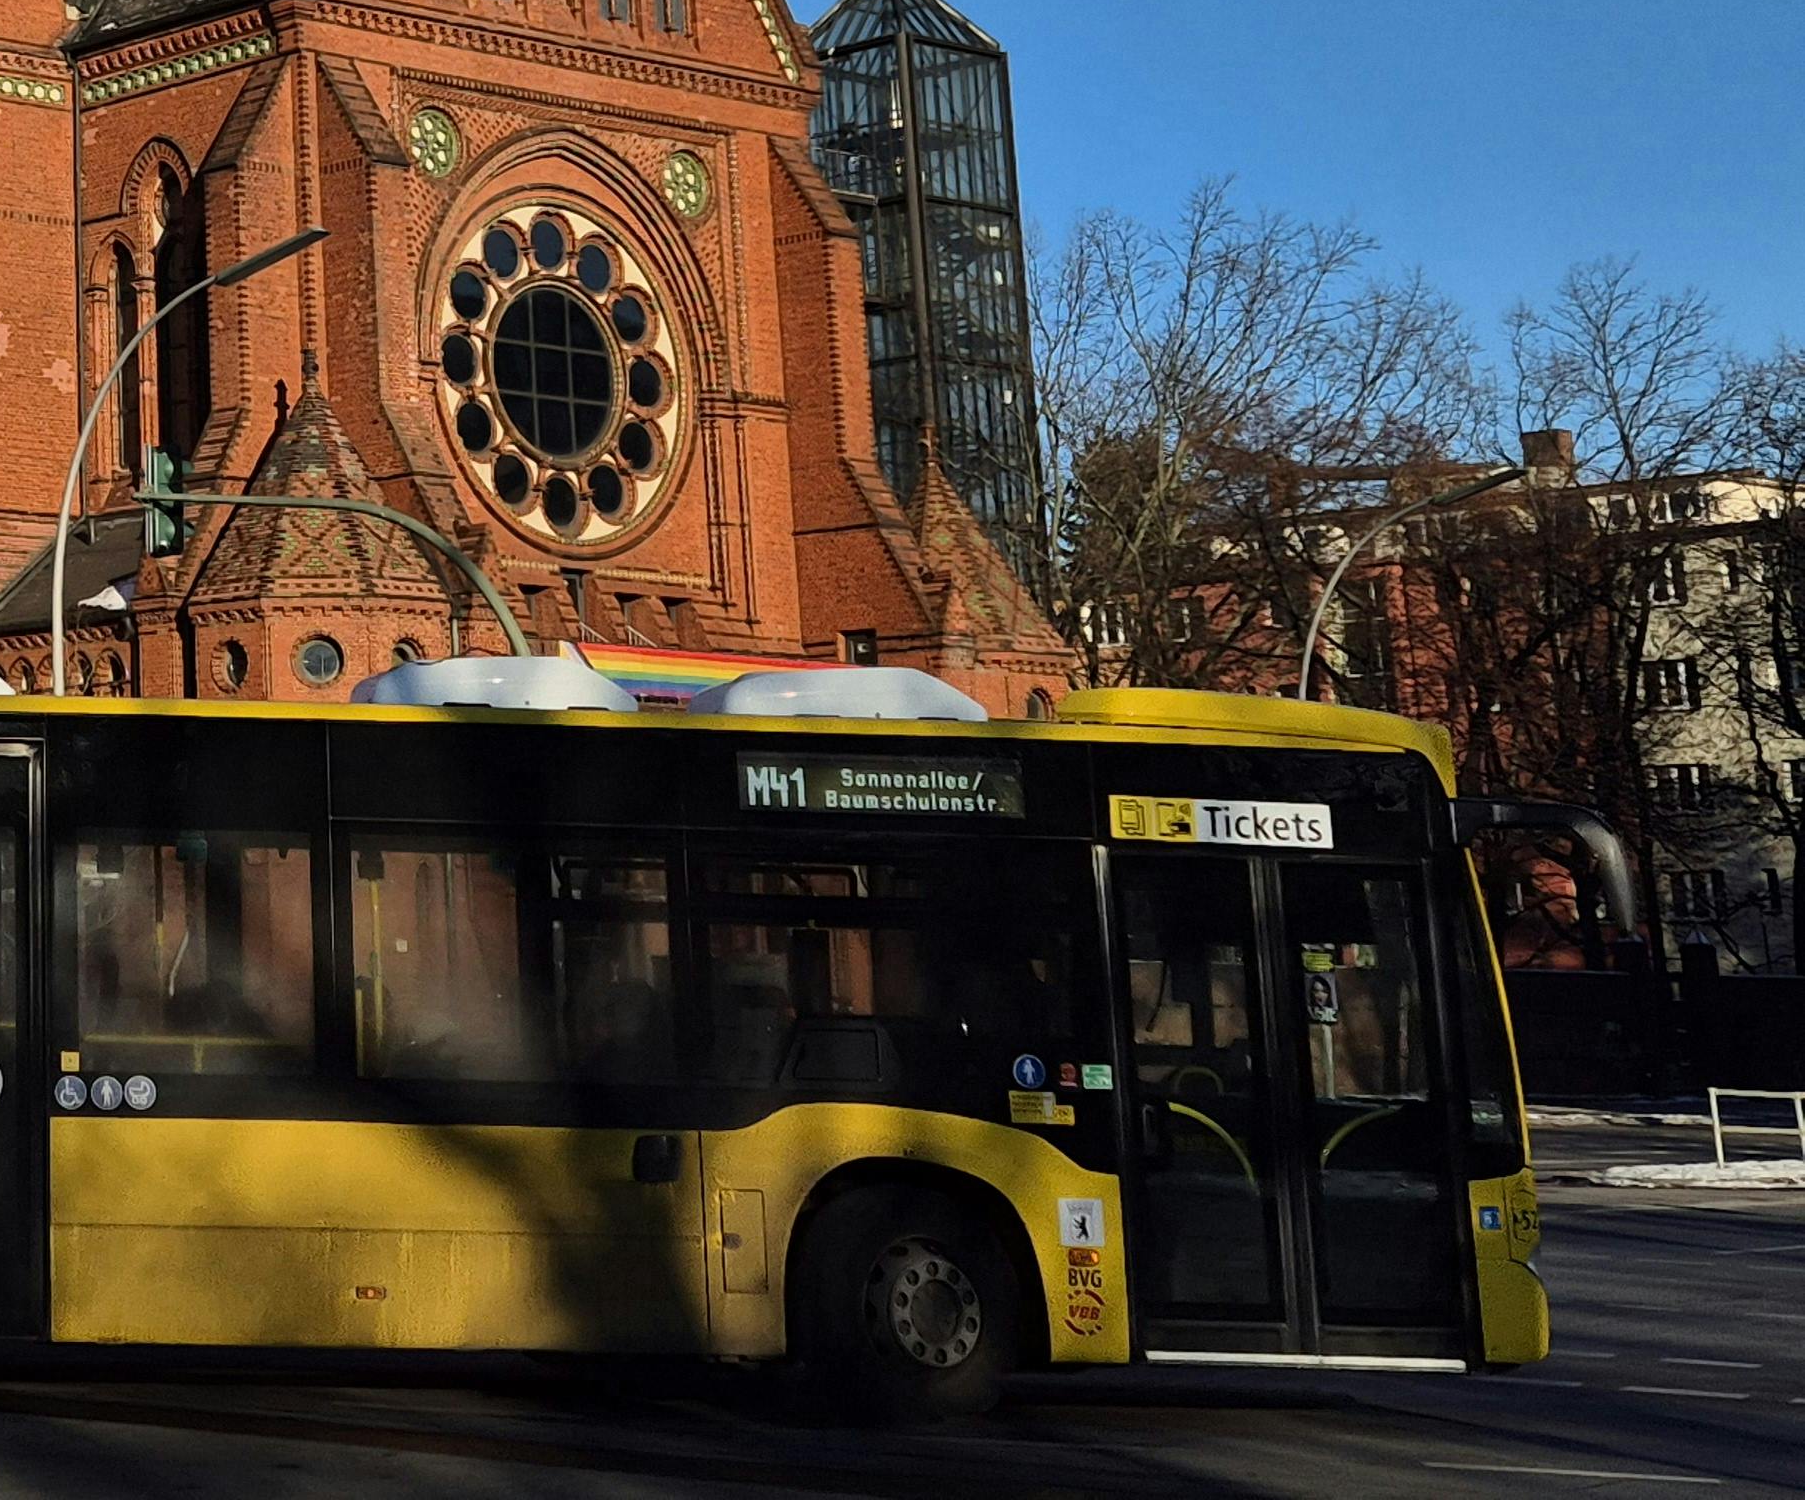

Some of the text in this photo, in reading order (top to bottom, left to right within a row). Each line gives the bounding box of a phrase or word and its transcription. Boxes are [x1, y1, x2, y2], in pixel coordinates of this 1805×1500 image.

[747, 766, 807, 807] M41
[825, 790, 1005, 813] Baumschulenstr.
[1202, 805, 1322, 843] Tickets
[1069, 1269, 1102, 1288] BVG
